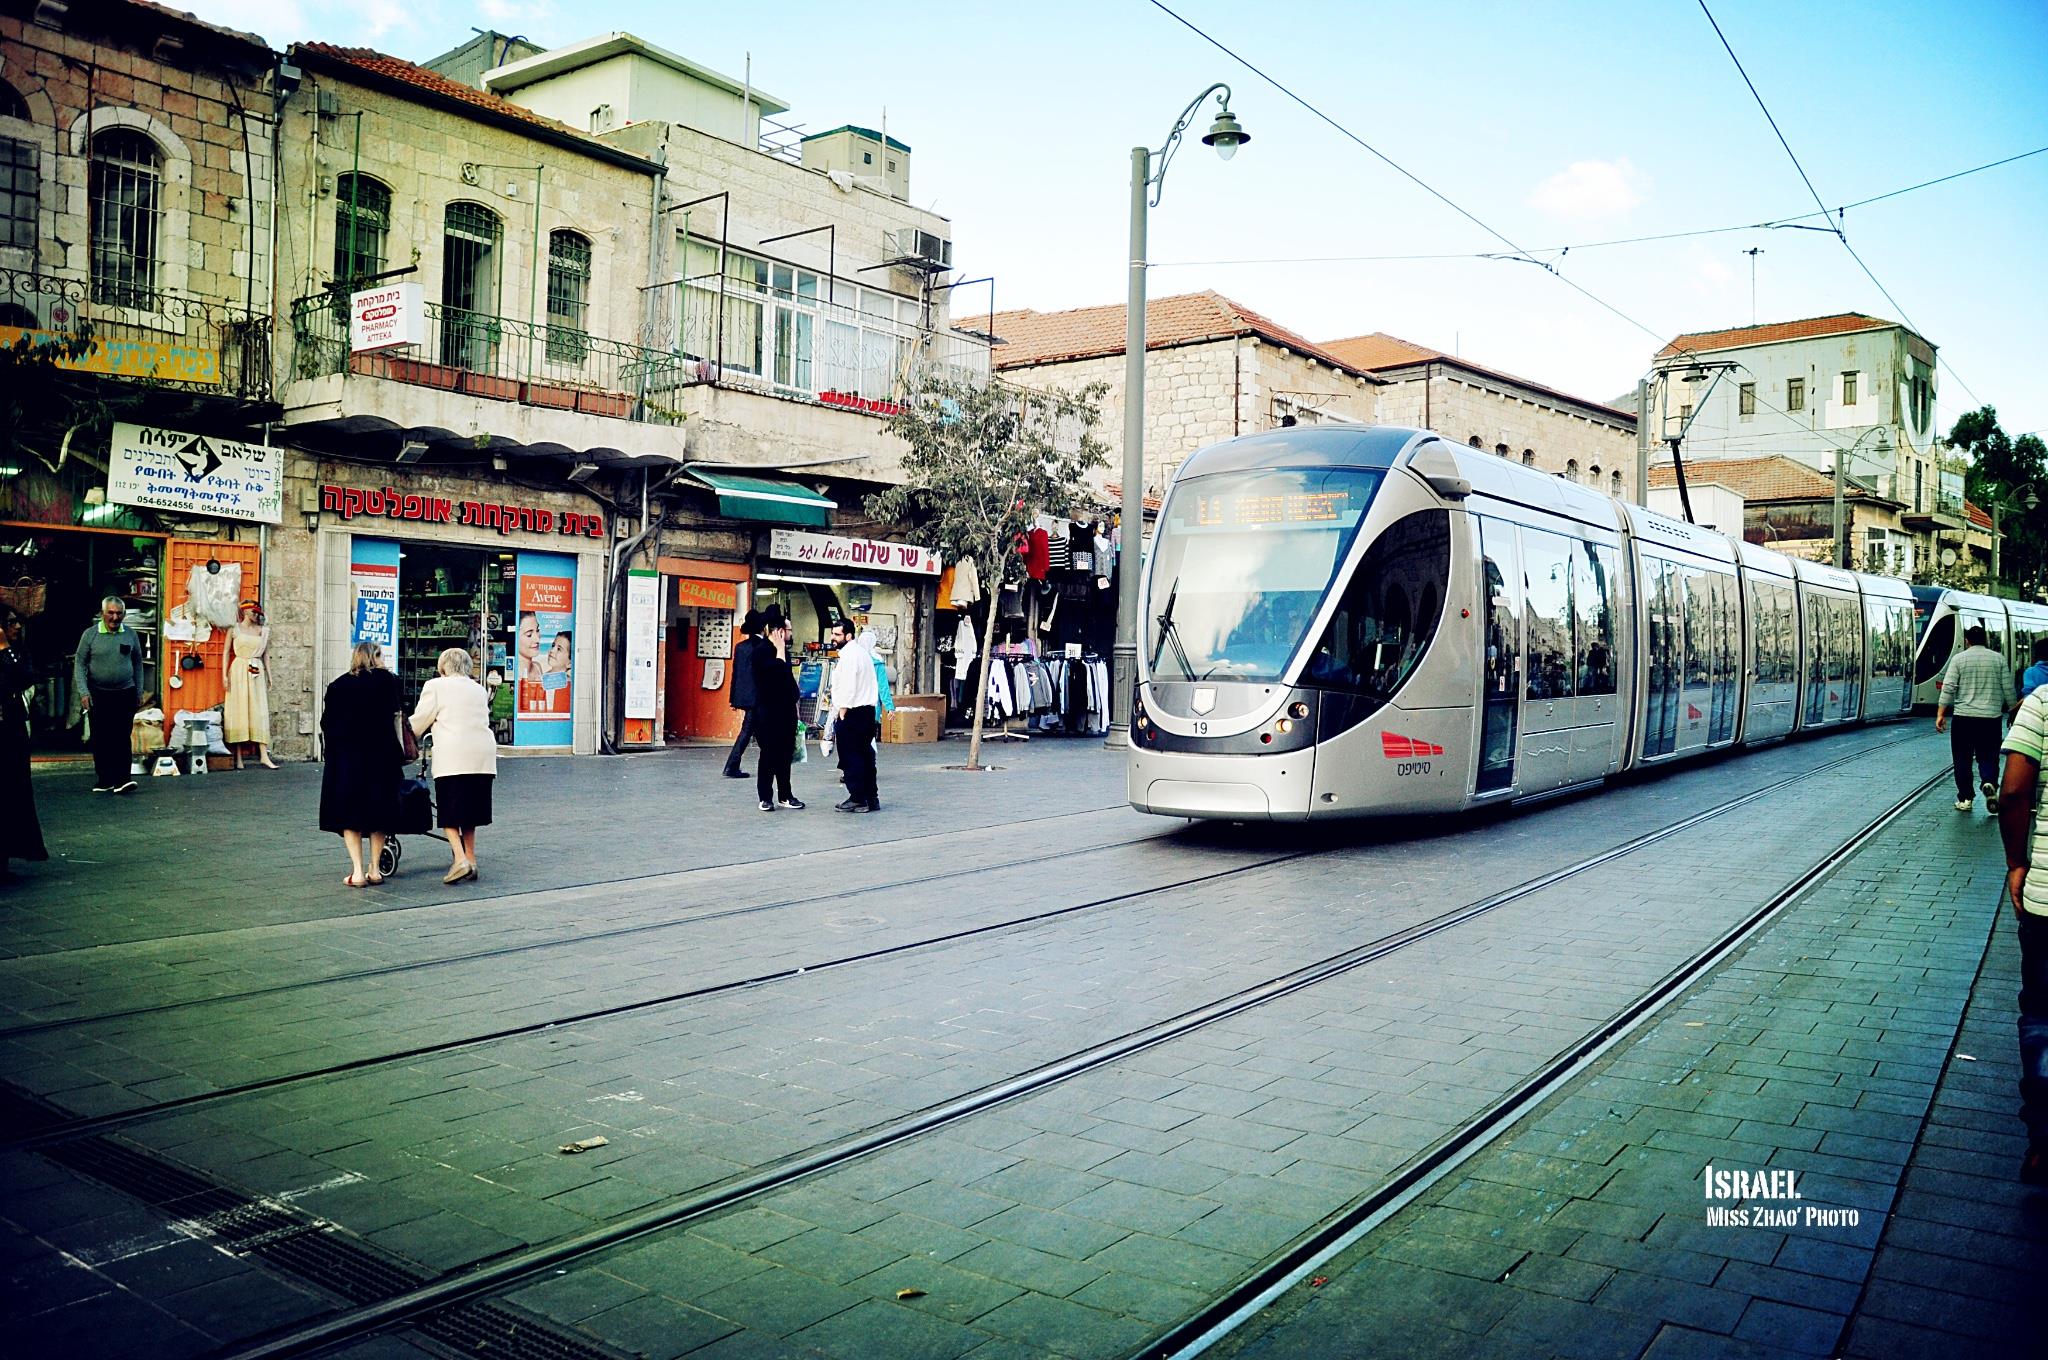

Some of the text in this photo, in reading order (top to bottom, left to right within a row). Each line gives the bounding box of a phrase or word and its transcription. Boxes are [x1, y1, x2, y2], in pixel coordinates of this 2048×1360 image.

[357, 291, 400, 308] בית מרקחת
[362, 319, 398, 333] PHARMACY
[221, 443, 266, 462] שלאם
[124, 448, 271, 480] ביוטי ותבלינים
[137, 496, 194, 510] 054-6524556
[201, 504, 255, 518] 054-5814778
[324, 484, 605, 537] בית מרקחת אופלטקה
[822, 541, 850, 561] חשמל
[852, 540, 890, 565] שלום
[898, 547, 918, 567] שר
[360, 588, 395, 600] הילו קומוד
[526, 582, 568, 592] EAU THERMALE
[1193, 722, 1207, 734] 19
